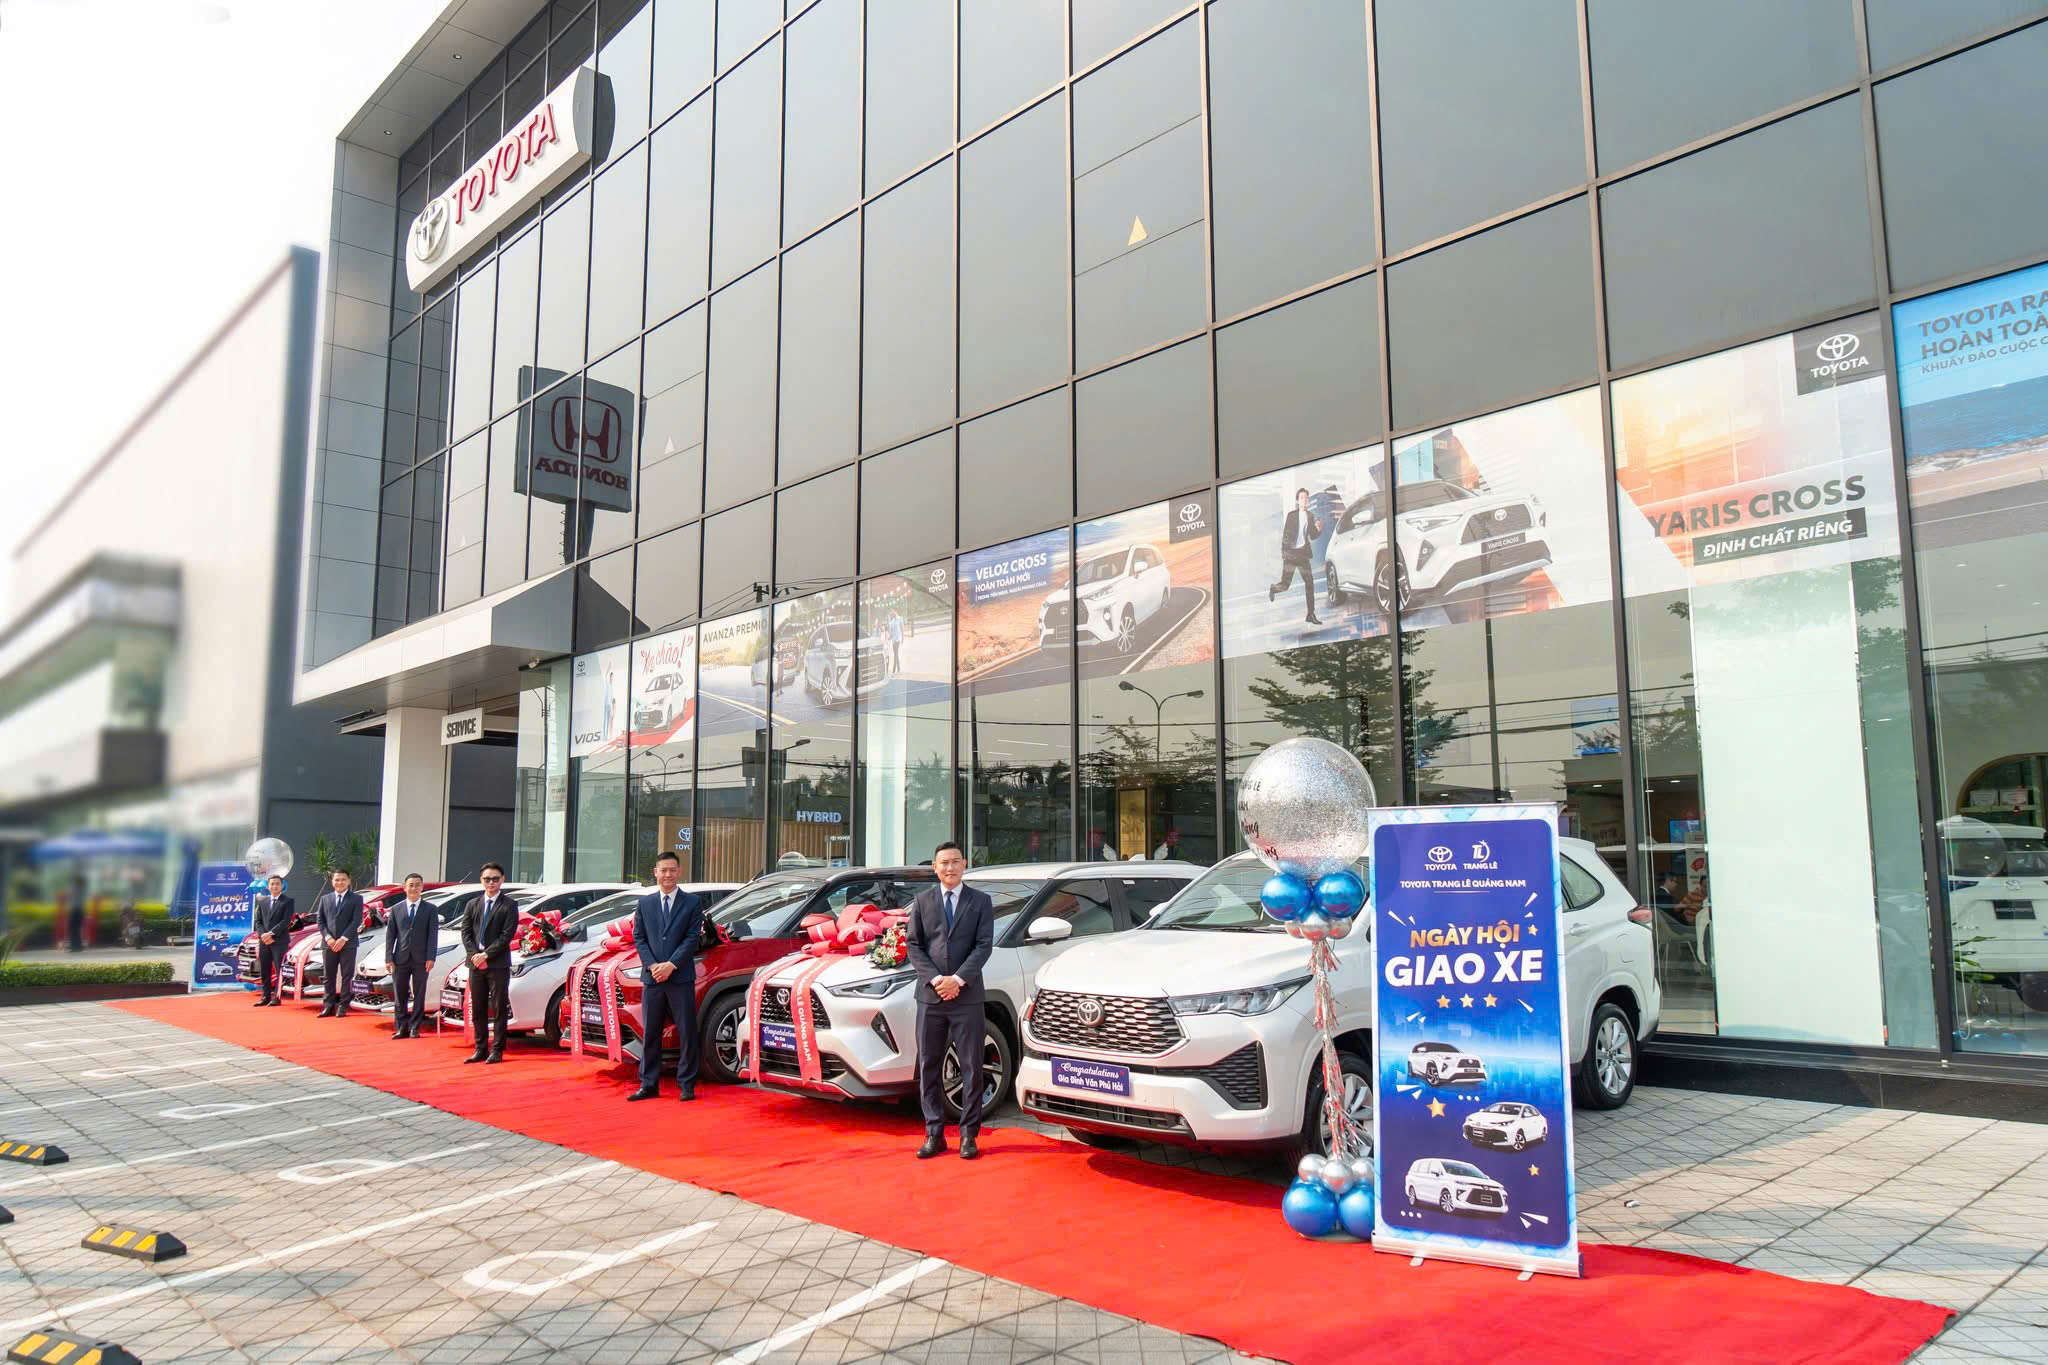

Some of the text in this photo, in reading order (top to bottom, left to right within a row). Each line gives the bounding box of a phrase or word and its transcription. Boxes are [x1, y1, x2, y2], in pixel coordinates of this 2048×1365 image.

[453, 104, 557, 224] TOYOTA
[1919, 301, 2016, 337] TOYOTA
[1921, 328, 1993, 360] HOÀN
[1811, 356, 1869, 378] TOYOTA
[1650, 475, 1866, 538] YARIS CROSS
[1176, 520, 1206, 534] TOYOTA
[1703, 518, 1853, 559] ĐỊNH CHẤT RIÊNG
[975, 553, 1048, 581] VELOZ CROSS
[703, 627, 735, 644] AVANZA
[446, 718, 477, 739] SERVICE
[574, 731, 602, 745] VIOS
[796, 810, 842, 824] HYBRID
[1424, 861, 1498, 871] TOYOTA TRANG LÊ
[1400, 877, 1526, 888] TOYOTA TRANG LÊ QUẢNG NAM
[200, 902, 249, 915] GIAO XE
[1410, 919, 1520, 949] NGÀY HỘI
[1384, 949, 1543, 987] GIAO XE
[802, 1040, 813, 1062] NAM
[1058, 1074, 1069, 1082] Gia
[1061, 1062, 1119, 1079] Congratulations
